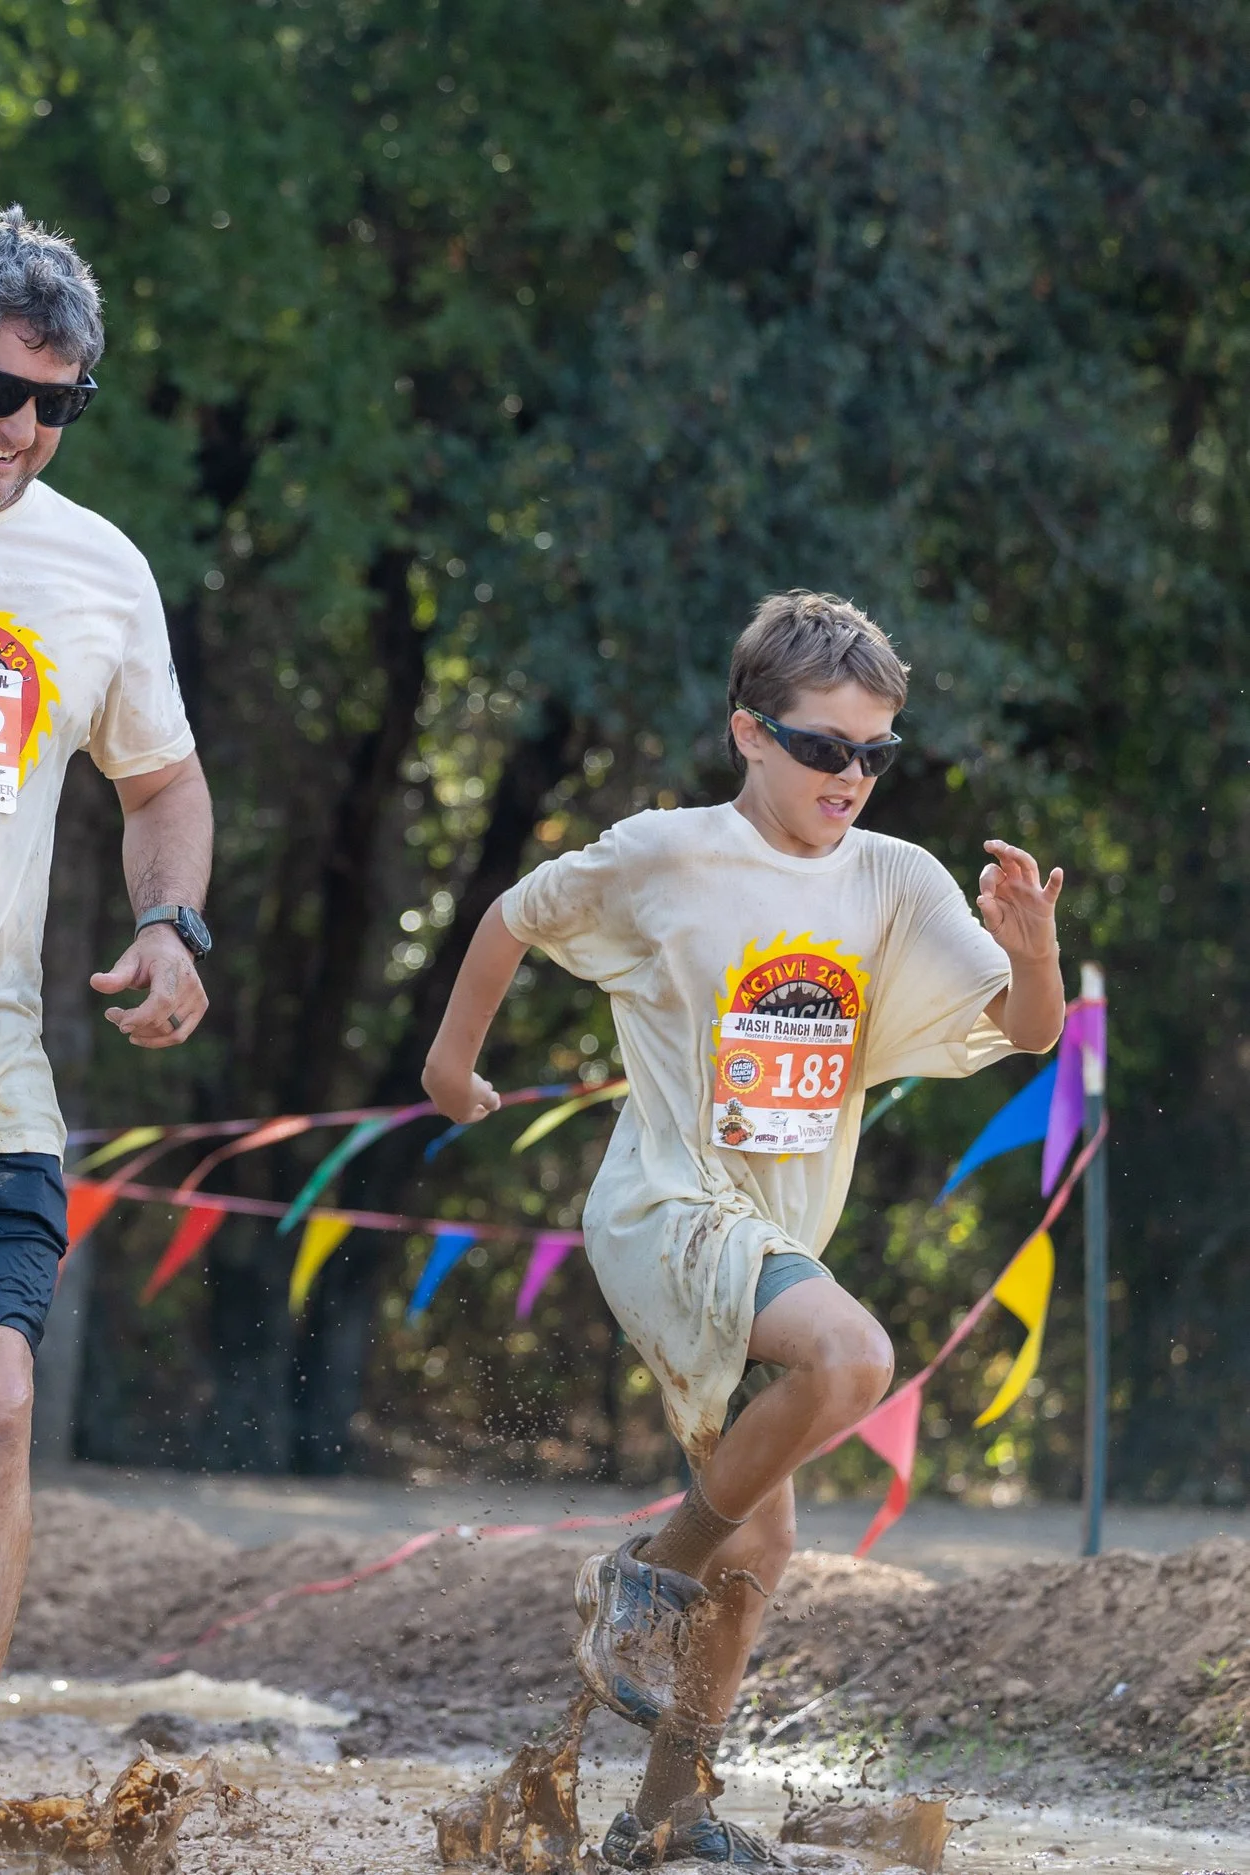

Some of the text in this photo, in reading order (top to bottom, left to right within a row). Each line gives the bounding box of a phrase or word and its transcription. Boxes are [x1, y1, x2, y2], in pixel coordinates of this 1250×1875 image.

[740, 961, 807, 1008] ACTIVE
[815, 965, 857, 1018] 20-30
[738, 1018, 848, 1038] NASH RANCH MUD RUN
[744, 1032, 764, 1040] hosted
[732, 1062, 752, 1071] NASH
[771, 1053, 844, 1099] 183
